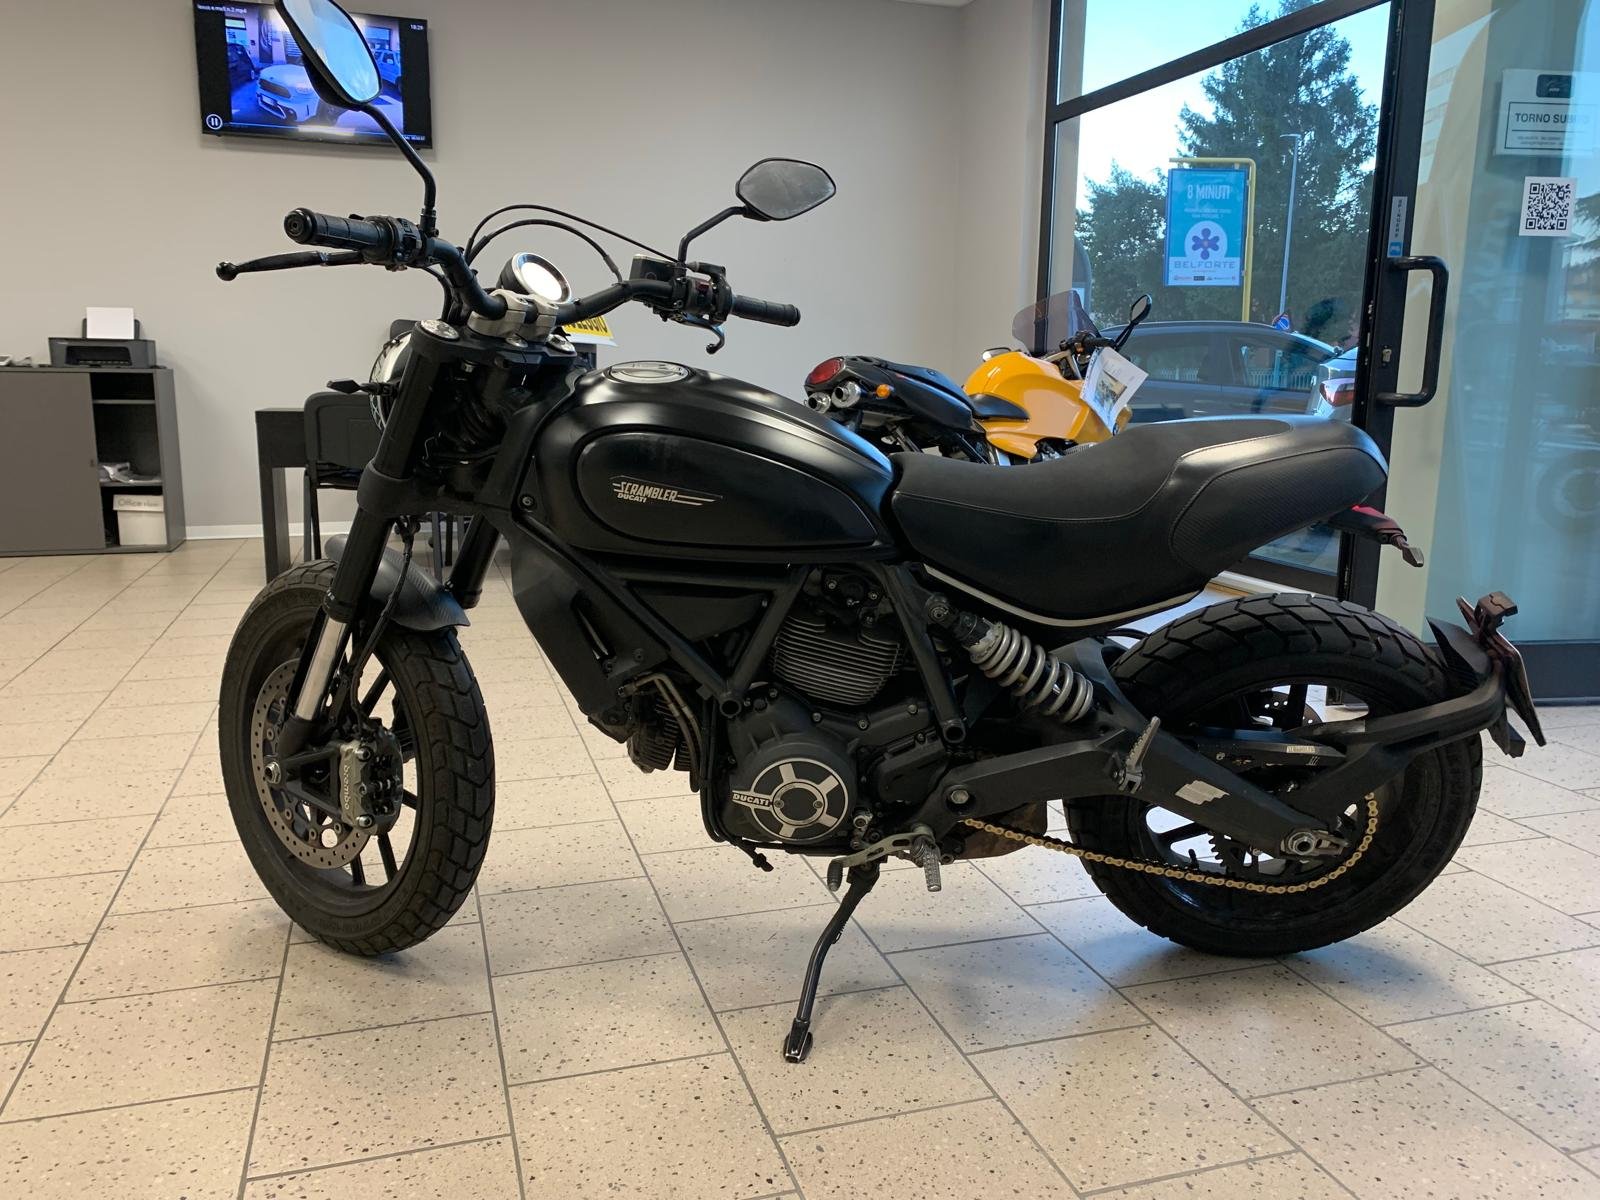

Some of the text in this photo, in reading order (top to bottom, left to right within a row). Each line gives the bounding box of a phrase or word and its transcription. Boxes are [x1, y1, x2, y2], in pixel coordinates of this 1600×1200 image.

[1515, 112, 1550, 123] TORNO
[1187, 184, 1231, 200] 8 MINUTI
[1174, 261, 1236, 269] BELFORTE
[617, 492, 647, 503] DUCATI
[620, 481, 678, 502] SCRAMBLER
[343, 764, 352, 810] brembo
[732, 793, 769, 806] DUCATI
